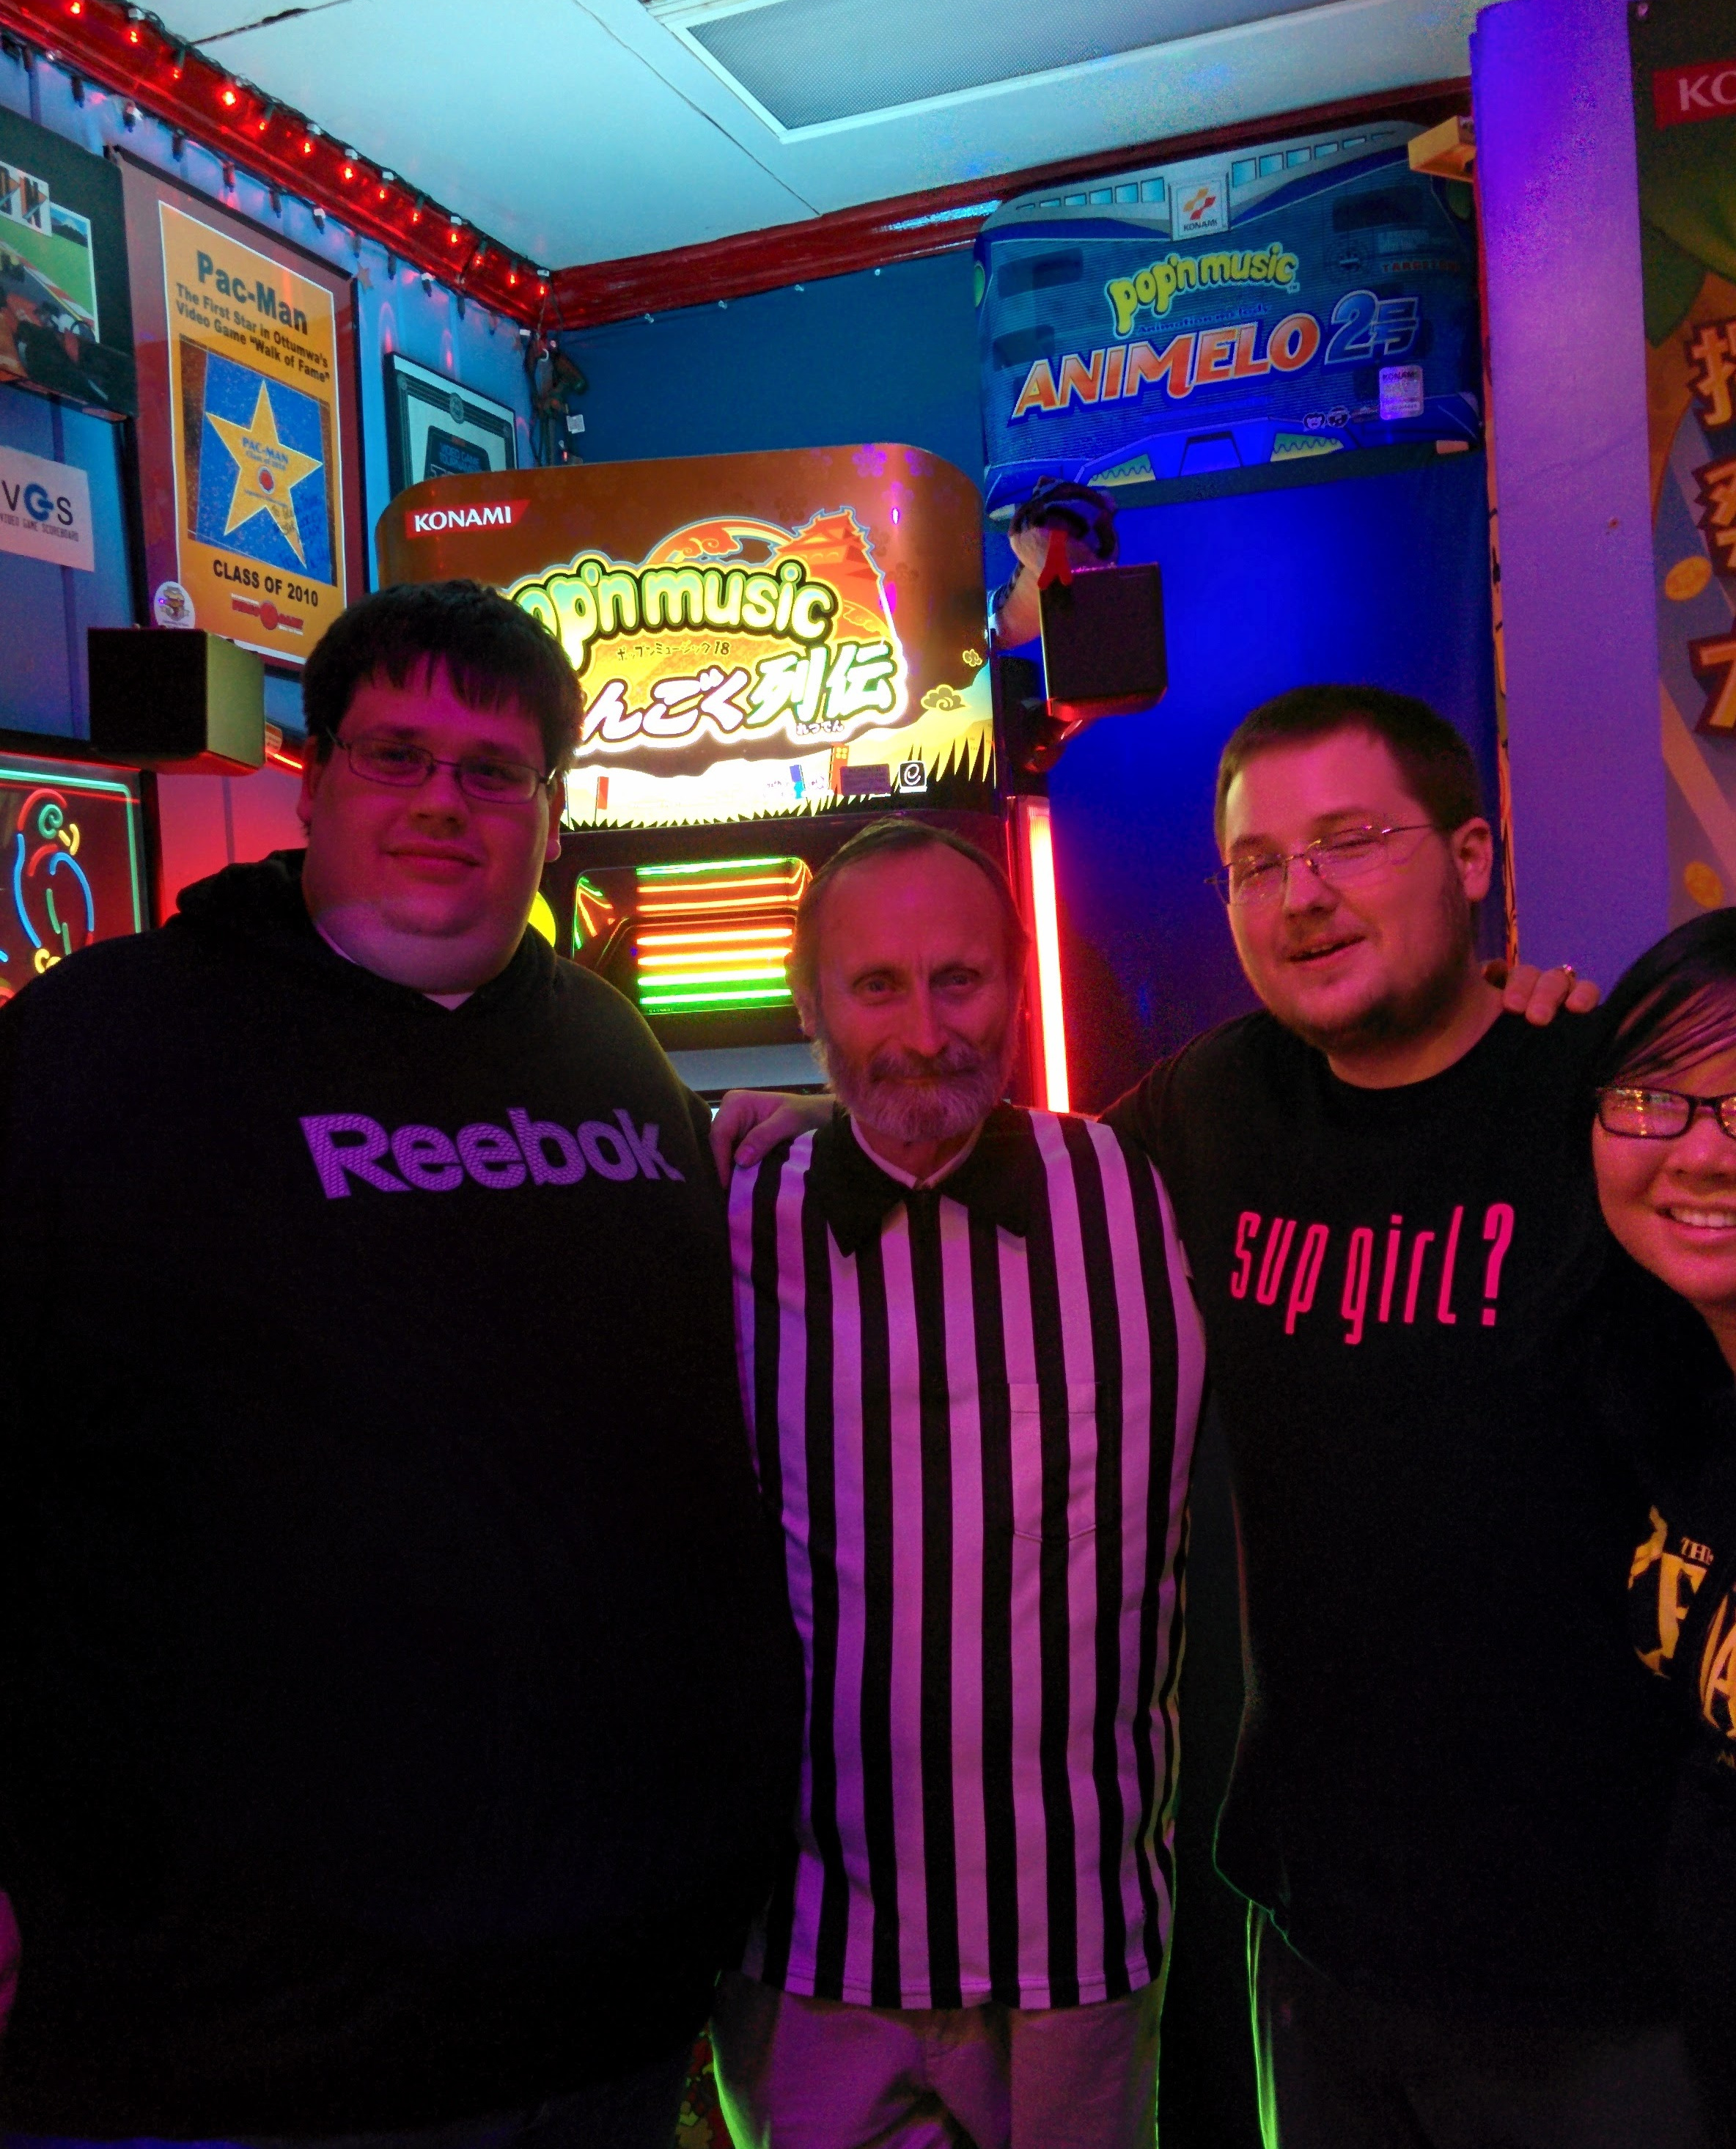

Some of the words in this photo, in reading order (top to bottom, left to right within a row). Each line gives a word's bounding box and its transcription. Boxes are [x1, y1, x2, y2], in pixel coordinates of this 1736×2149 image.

[1184, 218, 1218, 231] KONAMI
[177, 283, 199, 305] The
[203, 295, 230, 321] First
[234, 311, 257, 333] Star
[273, 331, 328, 368] Ottumwa's
[196, 250, 307, 335] Pac-Man
[1107, 254, 1198, 337] pop'n
[1199, 243, 1297, 286] music
[176, 300, 210, 328] Video
[214, 318, 246, 345] Game
[284, 356, 295, 368] of
[1012, 312, 1320, 419] ANIMELO
[242, 436, 288, 463] PAC-MAN
[1, 480, 73, 526] VGS
[413, 506, 513, 533] KONAMI
[213, 559, 260, 589] CLASS
[264, 576, 282, 595] OF
[287, 583, 318, 607] 2010
[644, 556, 839, 641] music
[299, 1107, 686, 1200] Reebok
[1231, 1211, 1329, 1335] sup
[1340, 1202, 1515, 1345] girl?
